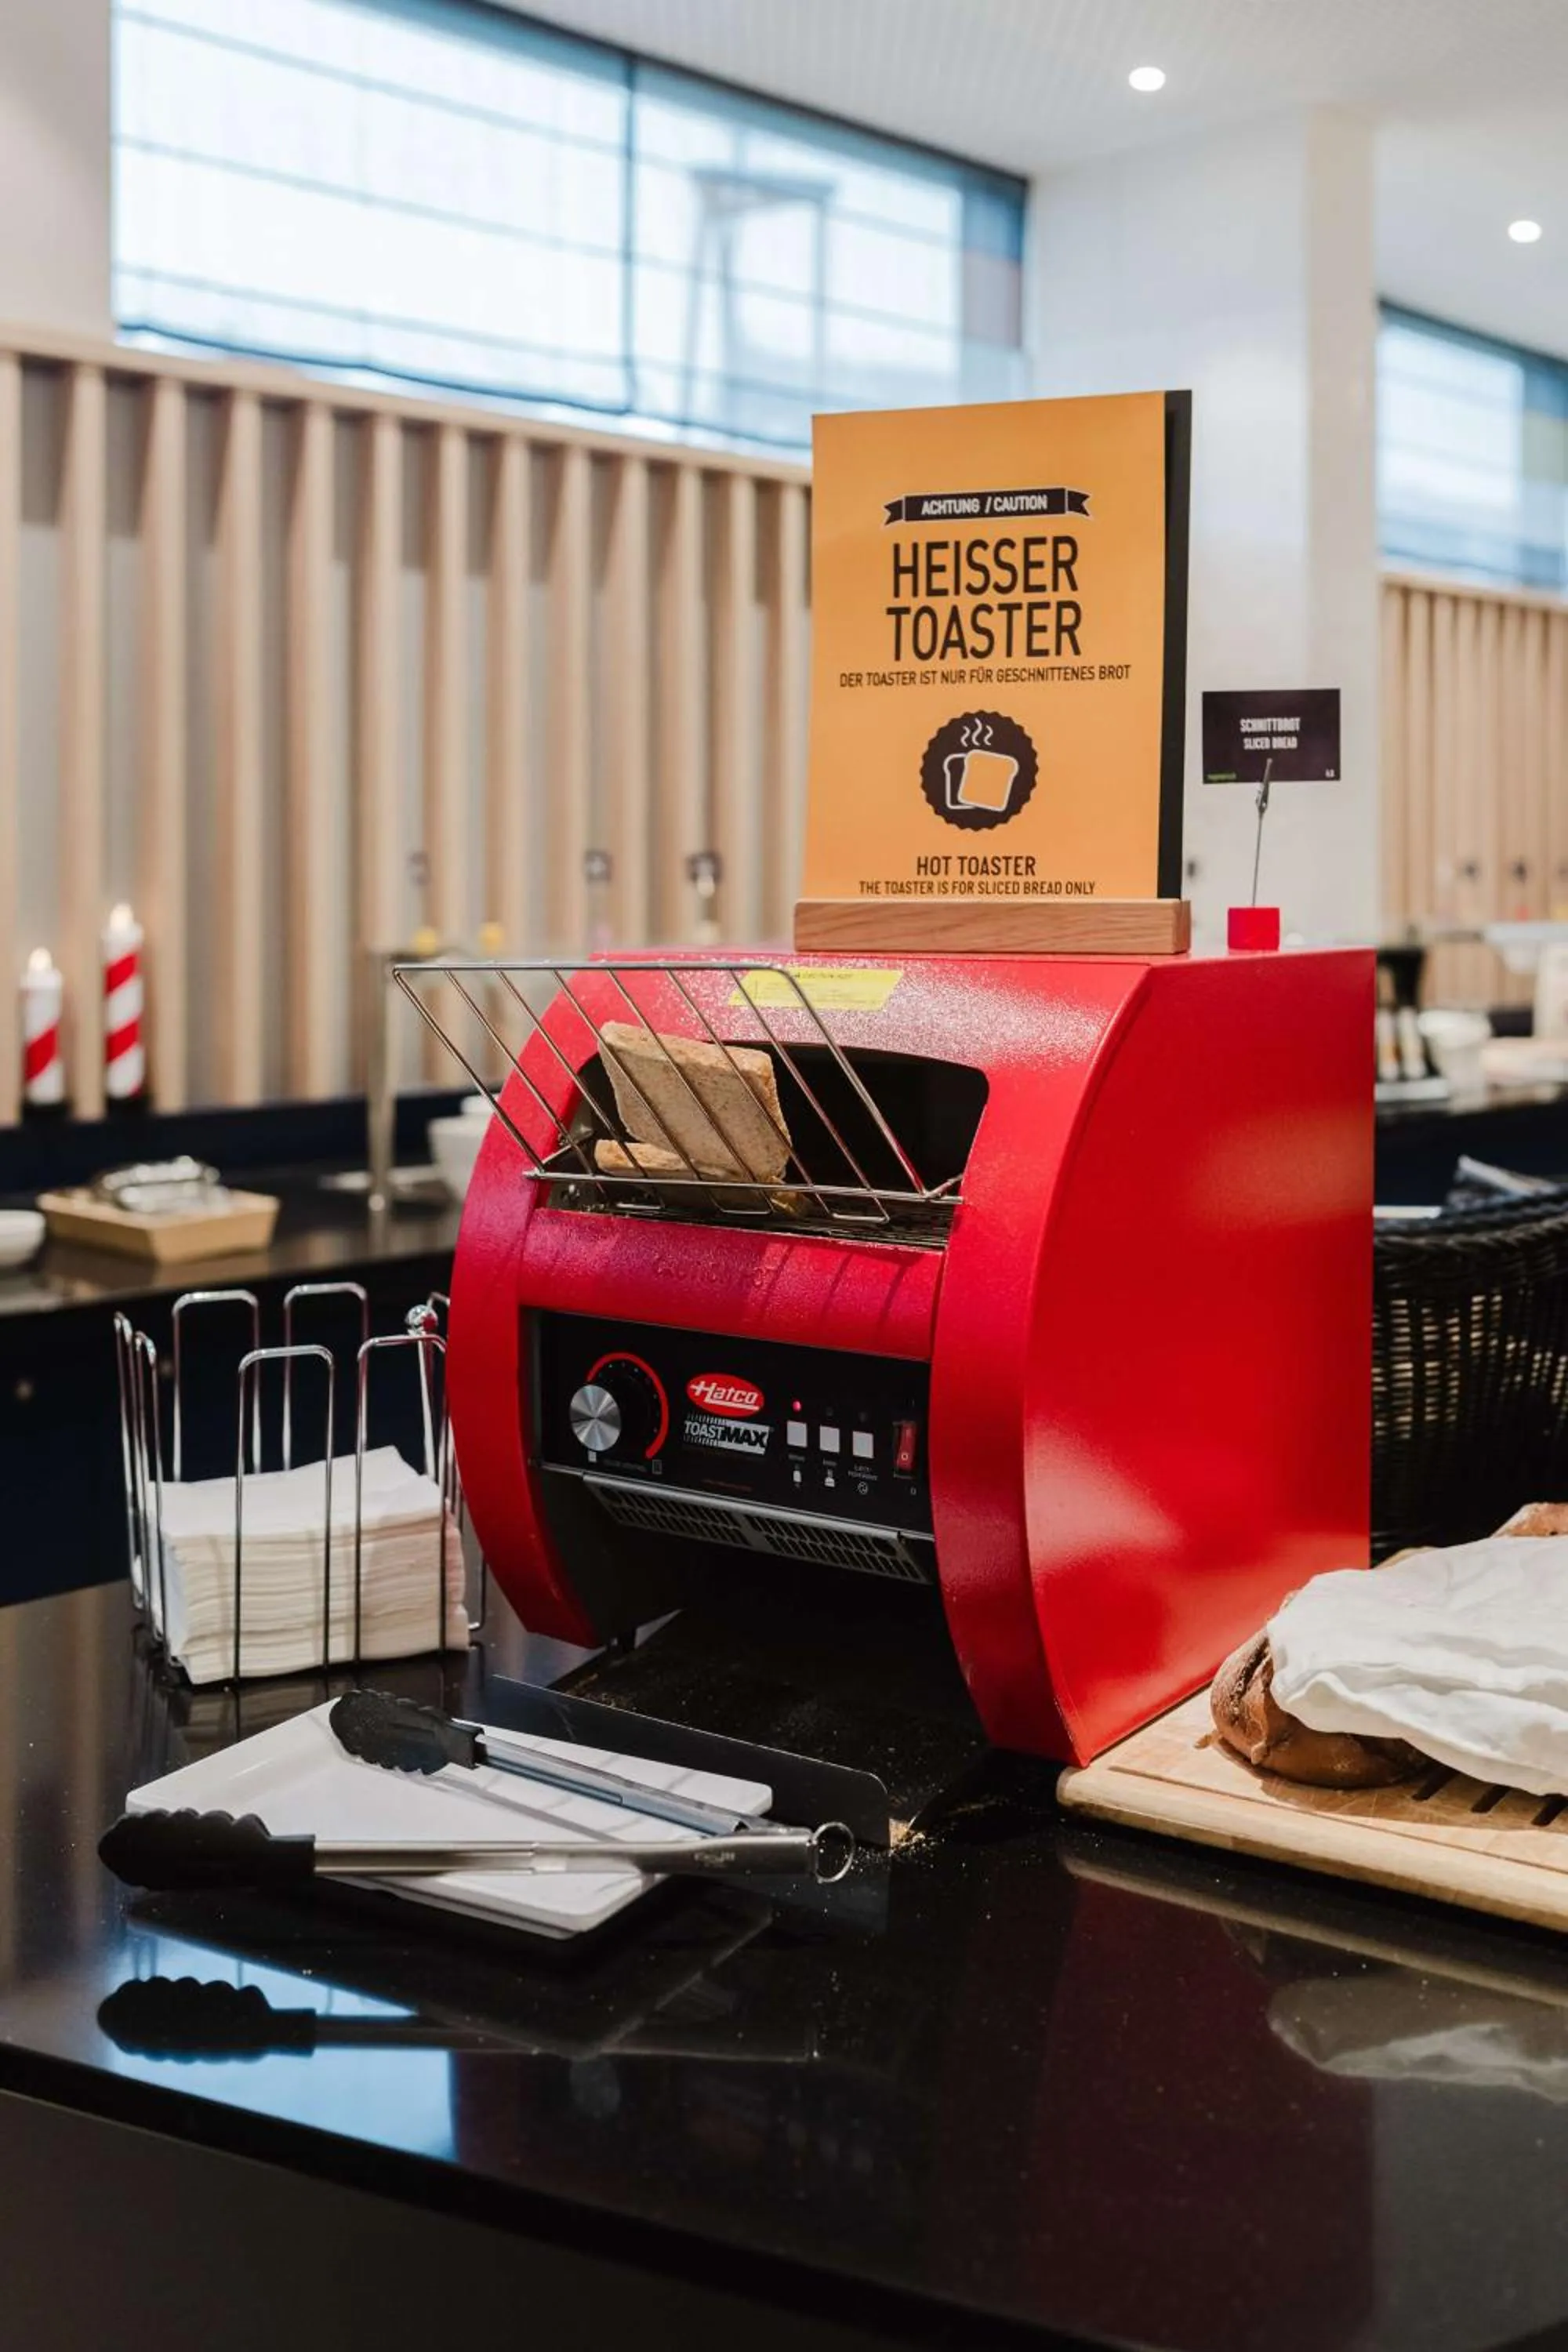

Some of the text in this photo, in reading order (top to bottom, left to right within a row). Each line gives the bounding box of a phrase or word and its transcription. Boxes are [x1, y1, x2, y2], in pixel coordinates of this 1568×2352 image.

[920, 499, 980, 516] ACHTUNG
[893, 535, 1079, 598] HEISSER
[885, 601, 1082, 662] TOASTER
[840, 664, 1131, 688] DER TOASTER IST NUR FÜR GESCHNITTENES BROT
[916, 855, 1036, 876] HOT TOASTER
[859, 880, 1095, 895] THE TOASTER IS FOR SLICED BREAD ONLY
[689, 1381, 760, 1410] Hatco
